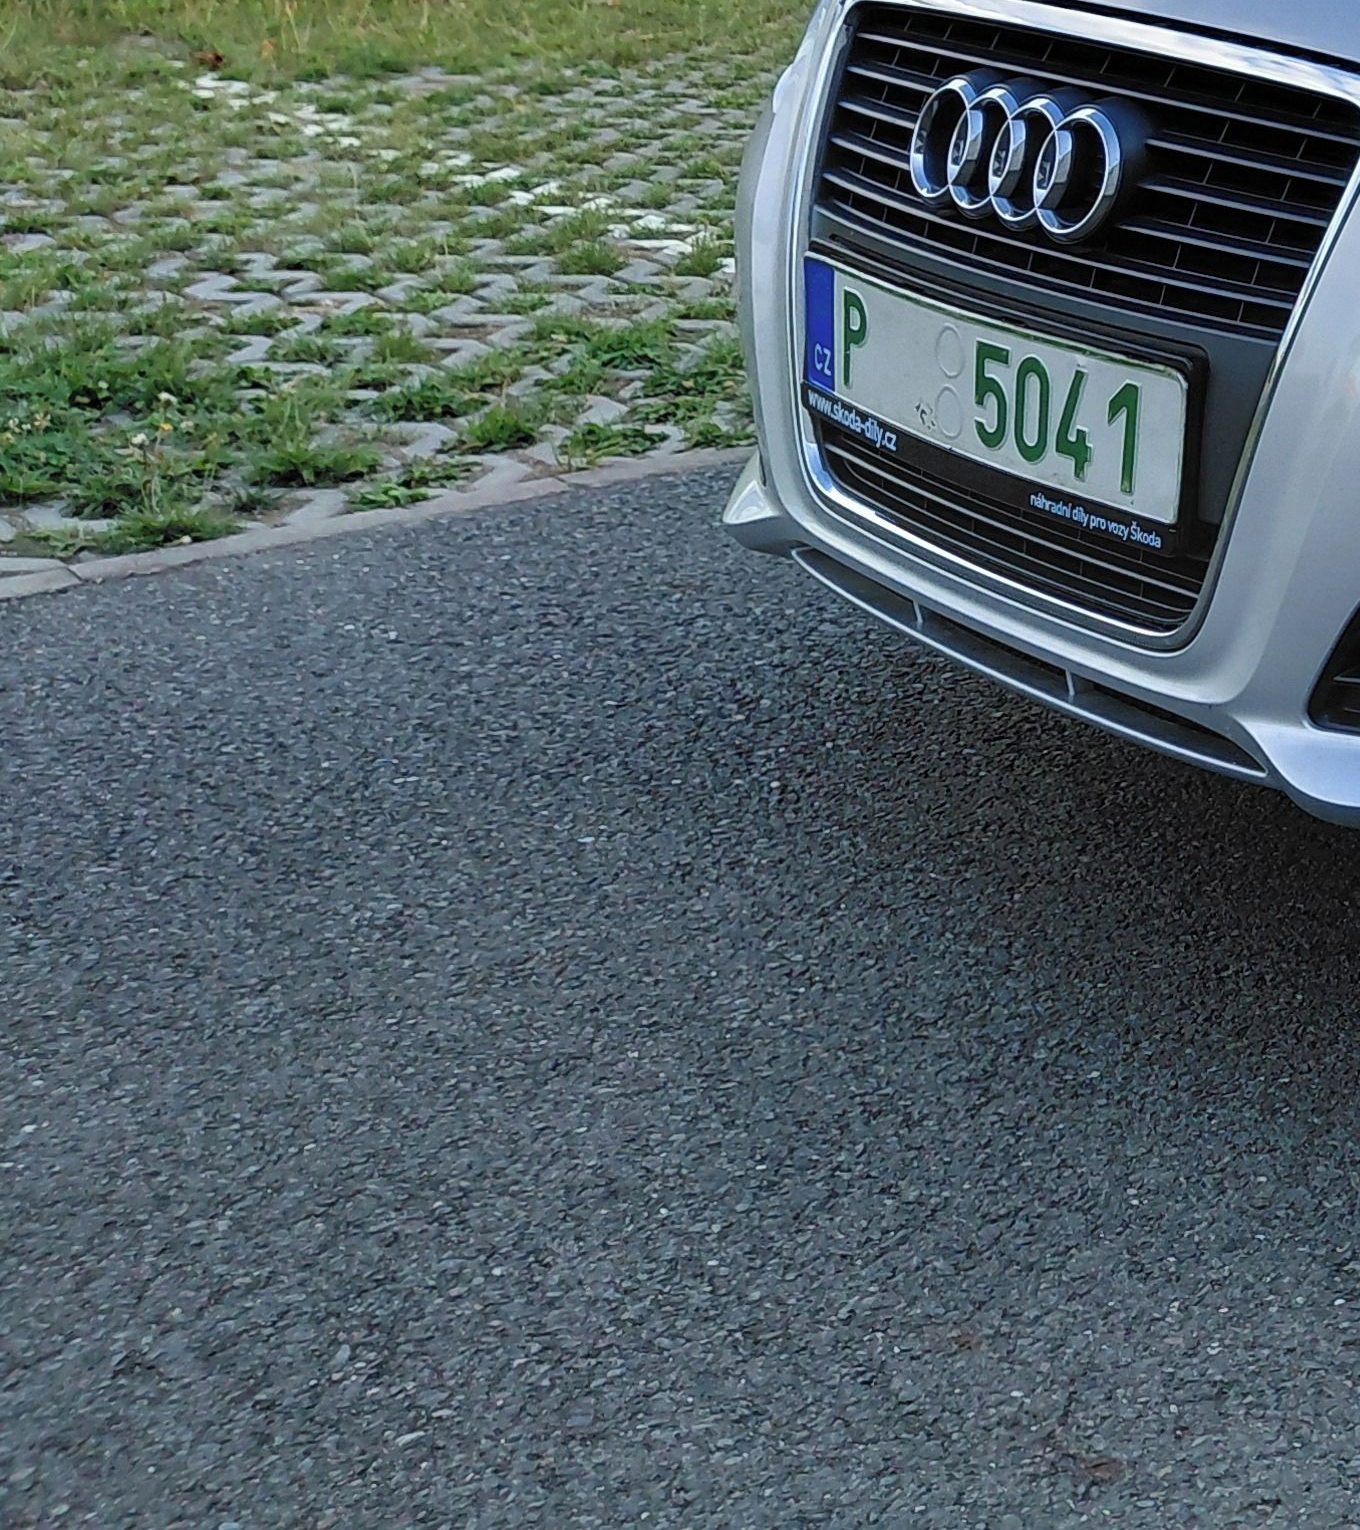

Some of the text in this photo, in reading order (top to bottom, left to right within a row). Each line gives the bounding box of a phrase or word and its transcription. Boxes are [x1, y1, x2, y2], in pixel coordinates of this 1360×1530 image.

[814, 342, 832, 376] CZ
[843, 287, 1142, 496] P 5041
[1089, 514, 1107, 530] pro
[1107, 520, 1129, 541] vozy
[1130, 520, 1162, 549] Škoda
